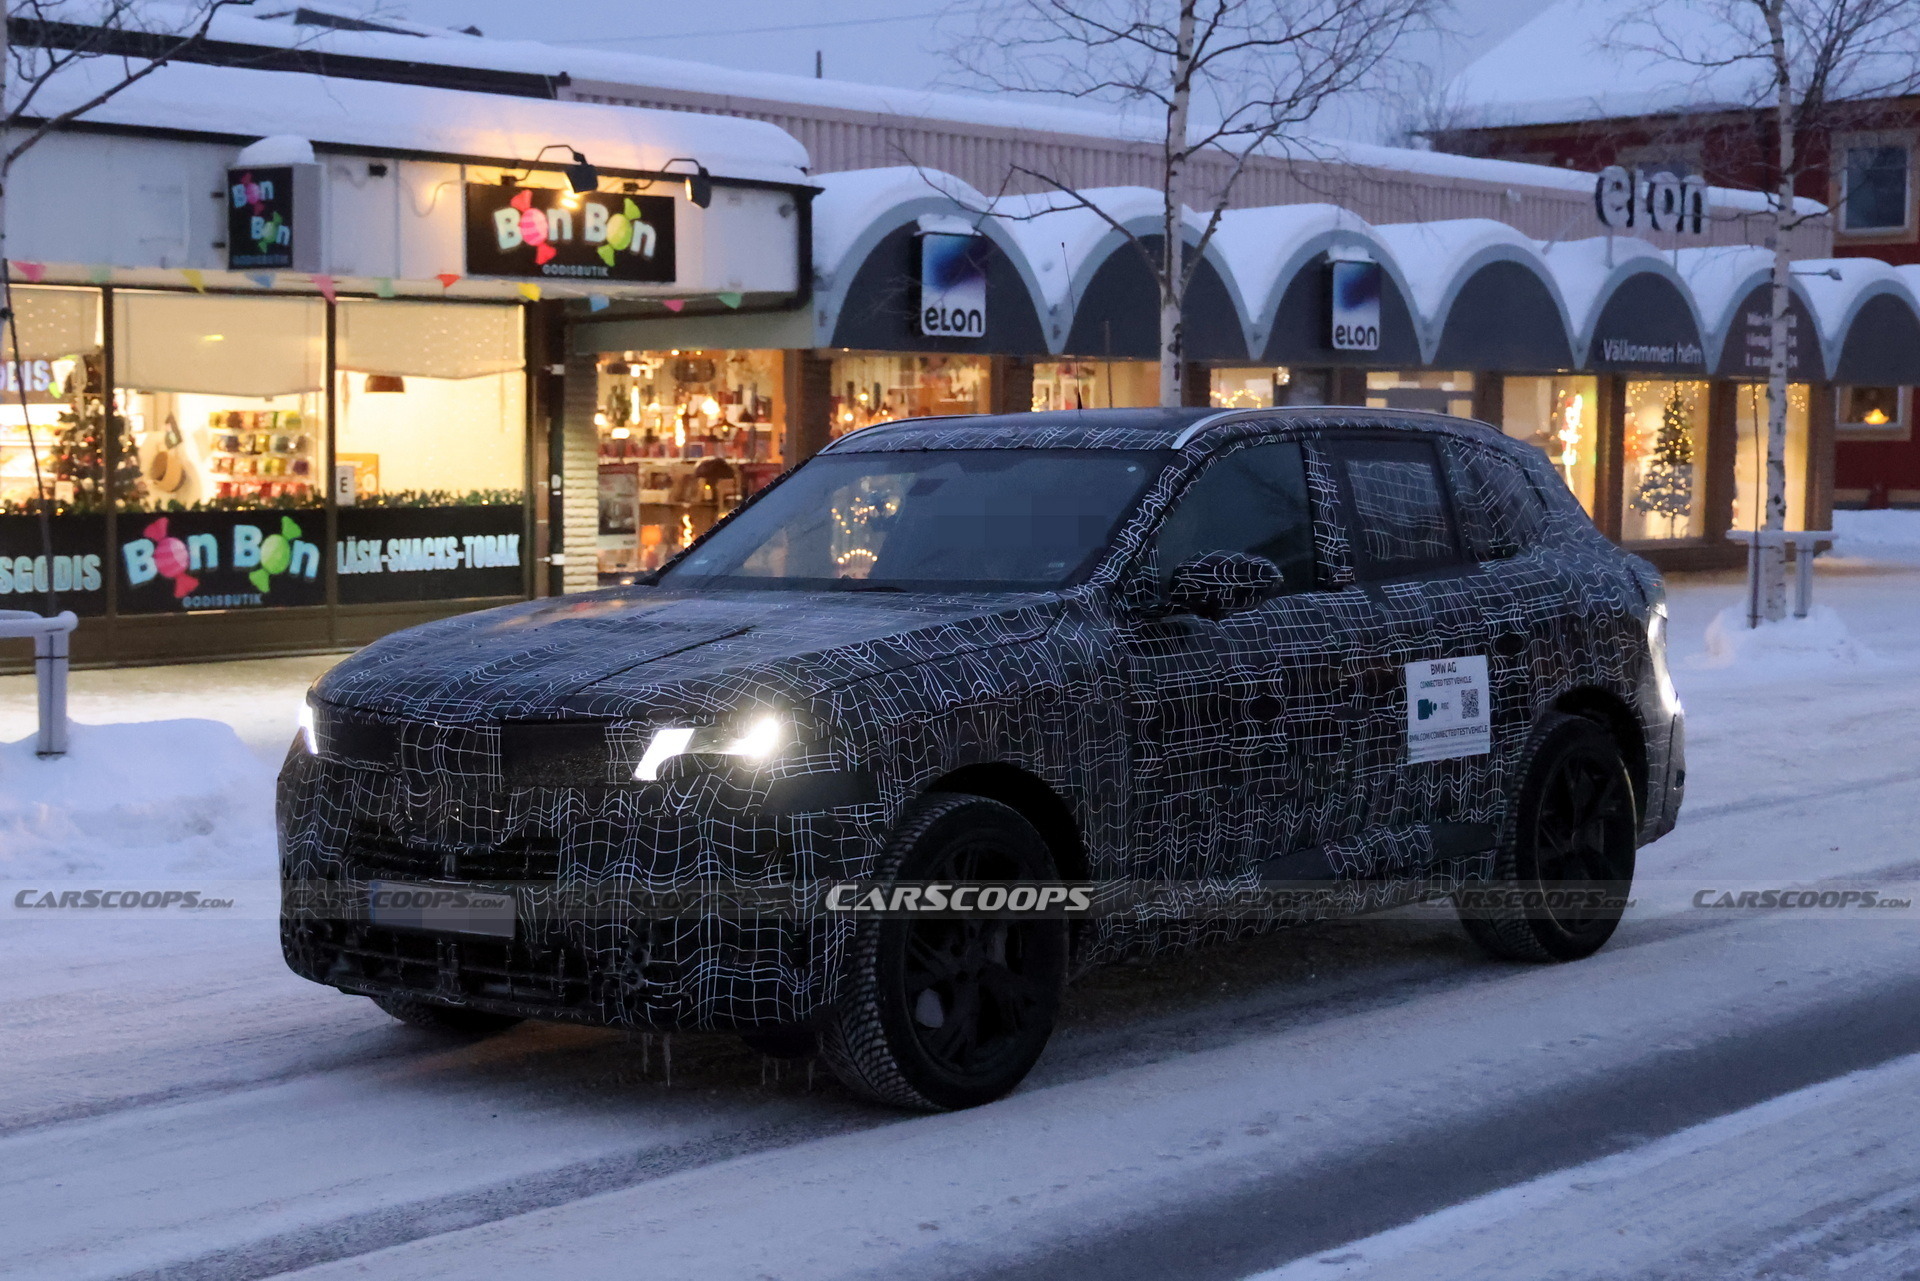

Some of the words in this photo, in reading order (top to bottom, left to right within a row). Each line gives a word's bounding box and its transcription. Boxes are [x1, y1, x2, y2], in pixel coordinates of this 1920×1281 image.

[232, 181, 274, 208] Bon
[251, 216, 290, 246] Bon
[494, 206, 573, 250] Bon
[584, 202, 657, 259] Bon
[1603, 338, 1674, 362] Välkommen
[0, 359, 50, 391] DIS
[122, 533, 219, 586] Bon
[233, 524, 320, 579] Bon
[1430, 663, 1446, 675] BMW
[1447, 661, 1457, 673] AG
[1420, 679, 1443, 689] CONNECTED
[1443, 677, 1454, 686] TEST
[1454, 676, 1472, 685] VEHICLE
